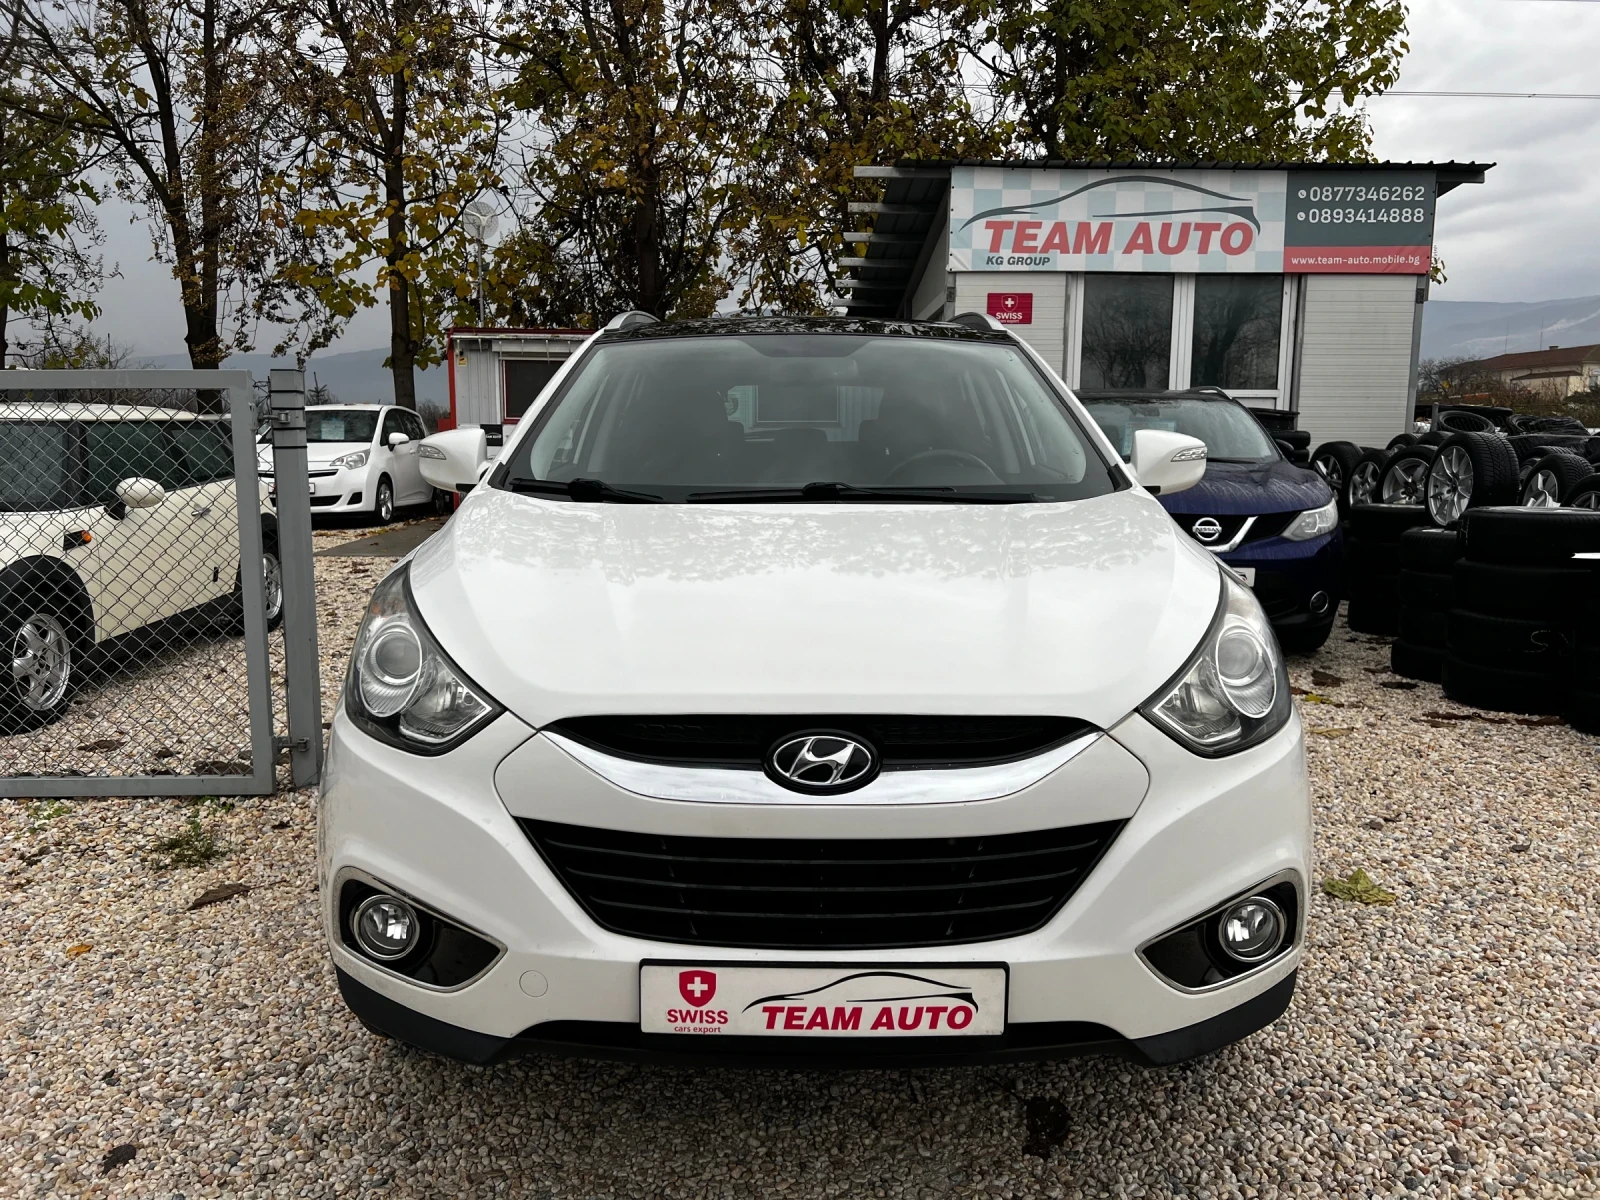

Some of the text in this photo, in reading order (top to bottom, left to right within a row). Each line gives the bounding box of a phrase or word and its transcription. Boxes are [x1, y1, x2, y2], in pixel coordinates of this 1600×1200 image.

[1309, 186, 1425, 202] 0877346262
[1308, 208, 1424, 223] 0893414888
[984, 220, 1254, 256] TEAM AUTO
[986, 255, 1050, 266] KG GROUP
[1291, 255, 1420, 266] www.team-auto.mobile.bg
[995, 312, 1023, 320] SWISS
[667, 1008, 729, 1025] SWISS
[762, 1005, 973, 1031] TEAM AUTO
[693, 1026, 721, 1035] export
